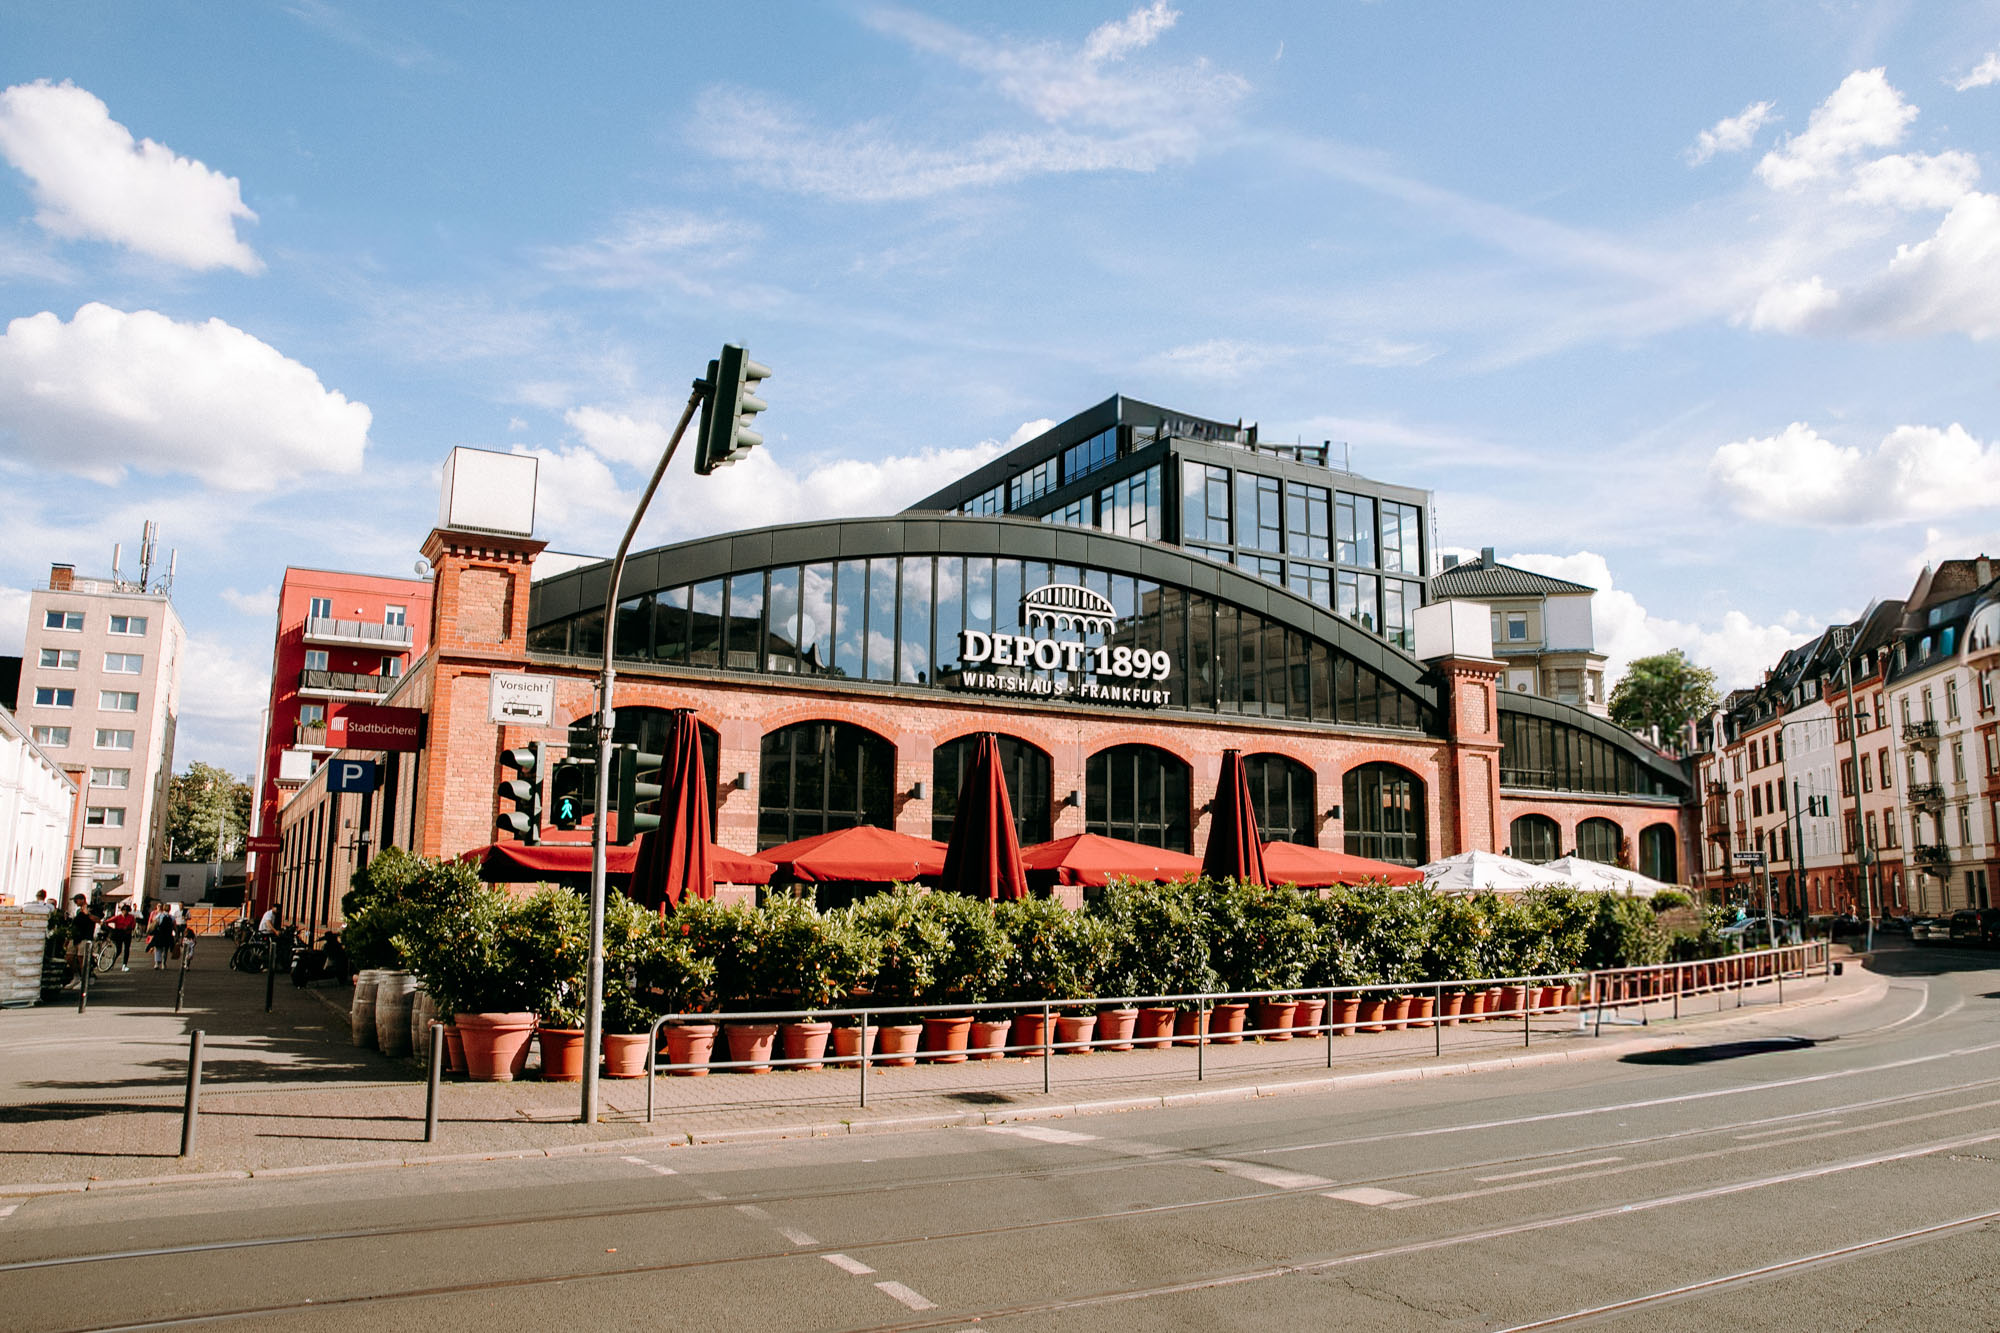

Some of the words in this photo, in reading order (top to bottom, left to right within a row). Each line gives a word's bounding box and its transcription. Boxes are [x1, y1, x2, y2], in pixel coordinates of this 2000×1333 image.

[963, 629, 1085, 672] DEPOT
[1094, 645, 1171, 681] 1899
[962, 671, 1063, 695] WIRTSHAUS
[1081, 683, 1171, 705] FRANKFURT
[348, 722, 417, 736] Stadtbücherei
[342, 763, 363, 788] P
